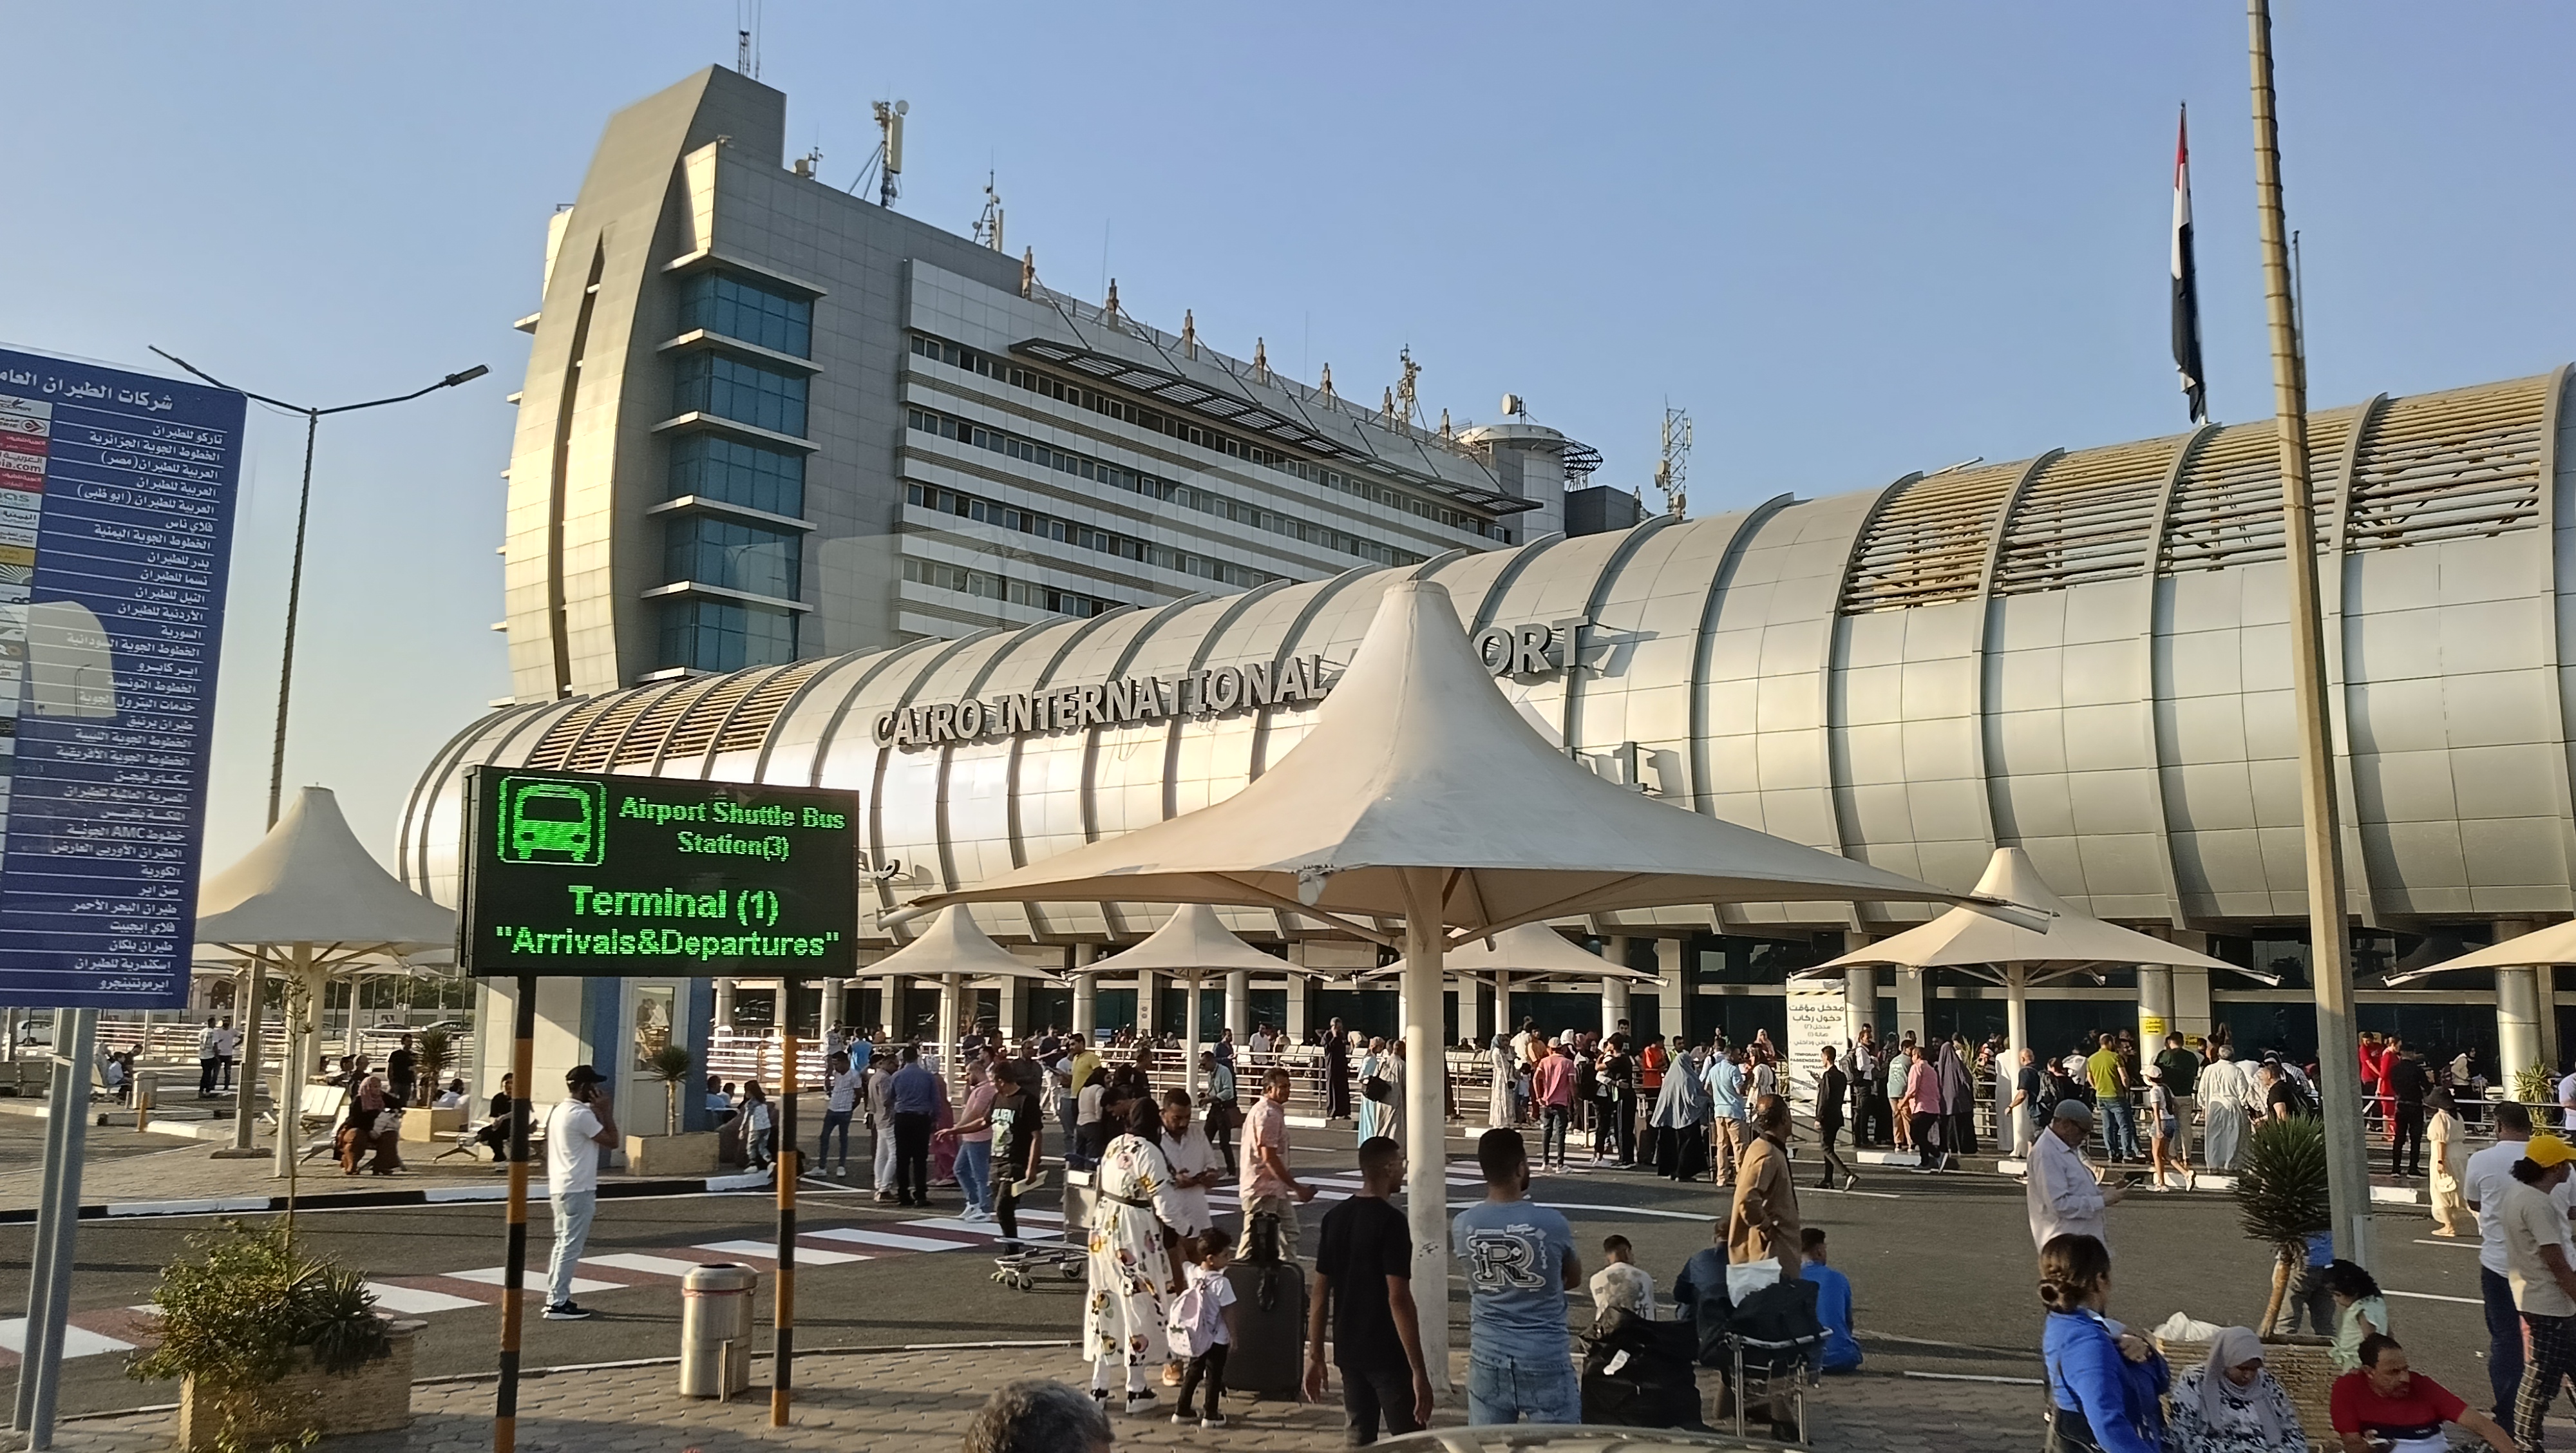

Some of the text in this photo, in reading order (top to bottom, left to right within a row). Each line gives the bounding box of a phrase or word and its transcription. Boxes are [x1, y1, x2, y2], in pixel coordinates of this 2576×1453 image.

[0, 369, 173, 411] شركات الطيران العام
[153, 426, 222, 444] تاركو للطيران
[143, 440, 176, 455] الجوية
[179, 446, 220, 461] الخطوط
[0, 459, 41, 472] ia.com
[182, 464, 218, 479] العربية
[137, 477, 216, 497] العربية للطيران
[134, 495, 176, 508] للطيران
[179, 500, 214, 514] العربية
[166, 519, 187, 529] ناس
[94, 524, 210, 549] الخطوط الجوية اليمنية
[147, 552, 209, 570] بدر للطيران
[140, 569, 207, 585] نسما للطيران
[135, 587, 205, 604] النيل للطيران
[118, 603, 160, 616] للطيران
[161, 625, 201, 640] السورية
[68, 633, 199, 656] الخطوط الجوية السودانية
[108, 676, 196, 694] الخطوط التونسية
[872, 616, 1593, 748] CAIRO INTERNATIONAL ORT
[117, 696, 156, 710] البترول
[160, 701, 195, 711] خدمات
[111, 732, 146, 745] الجوية
[149, 736, 191, 748] الخطوط
[110, 750, 145, 764] الجوية
[147, 754, 190, 766] الخطوط
[618, 797, 846, 829] Airport Shuttle Bus
[111, 826, 146, 838] AMC
[141, 864, 180, 878] الكورية
[110, 902, 140, 914] البحر
[142, 904, 177, 915] طيران
[567, 885, 779, 926] Terminal (1)
[138, 941, 173, 953] طيران
[75, 958, 119, 970] للطيران
